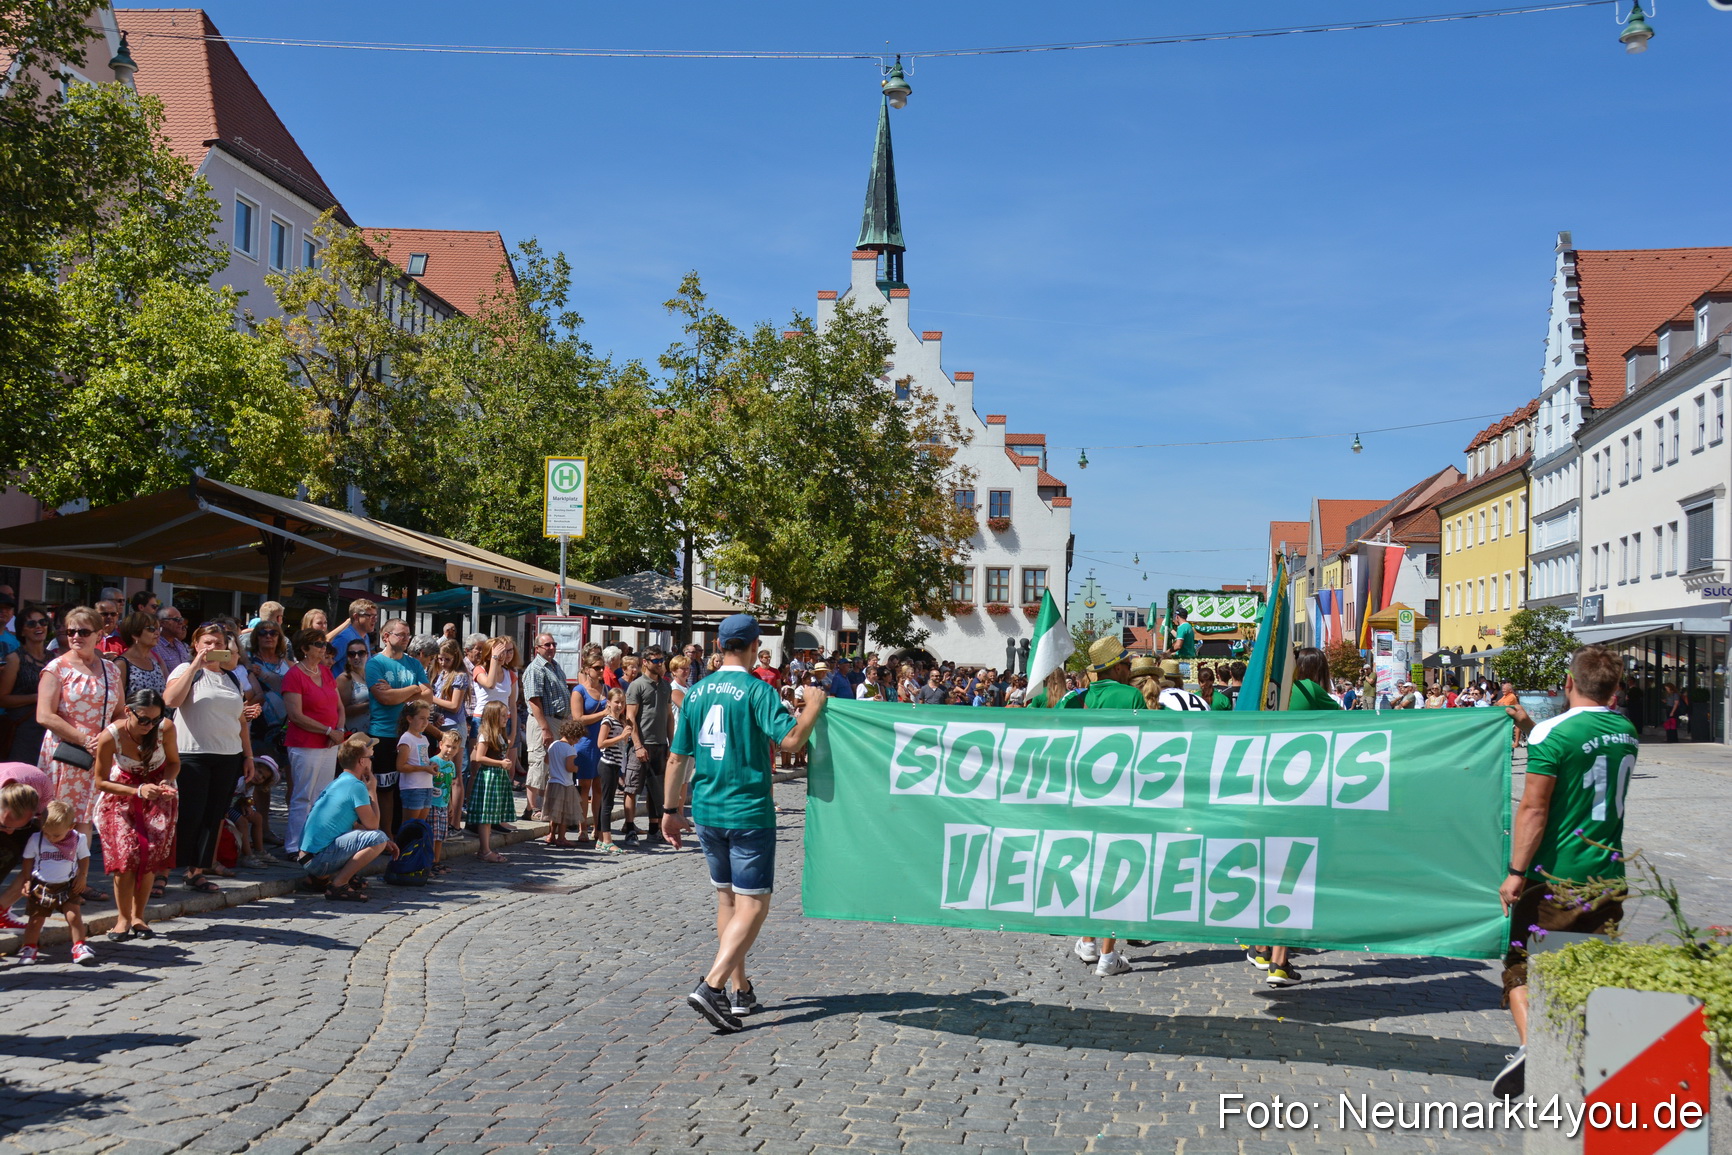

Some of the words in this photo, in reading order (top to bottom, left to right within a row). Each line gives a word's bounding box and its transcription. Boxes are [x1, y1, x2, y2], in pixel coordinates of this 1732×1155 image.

[559, 470, 573, 486] H
[690, 685, 704, 702] SV
[707, 682, 745, 701] Pölling
[698, 704, 727, 760] 4
[1582, 737, 1599, 754] SV
[894, 727, 1189, 801] SOMOS
[1216, 731, 1388, 804] LOS
[1582, 754, 1636, 821] 10
[943, 832, 1316, 925] VERDES!
